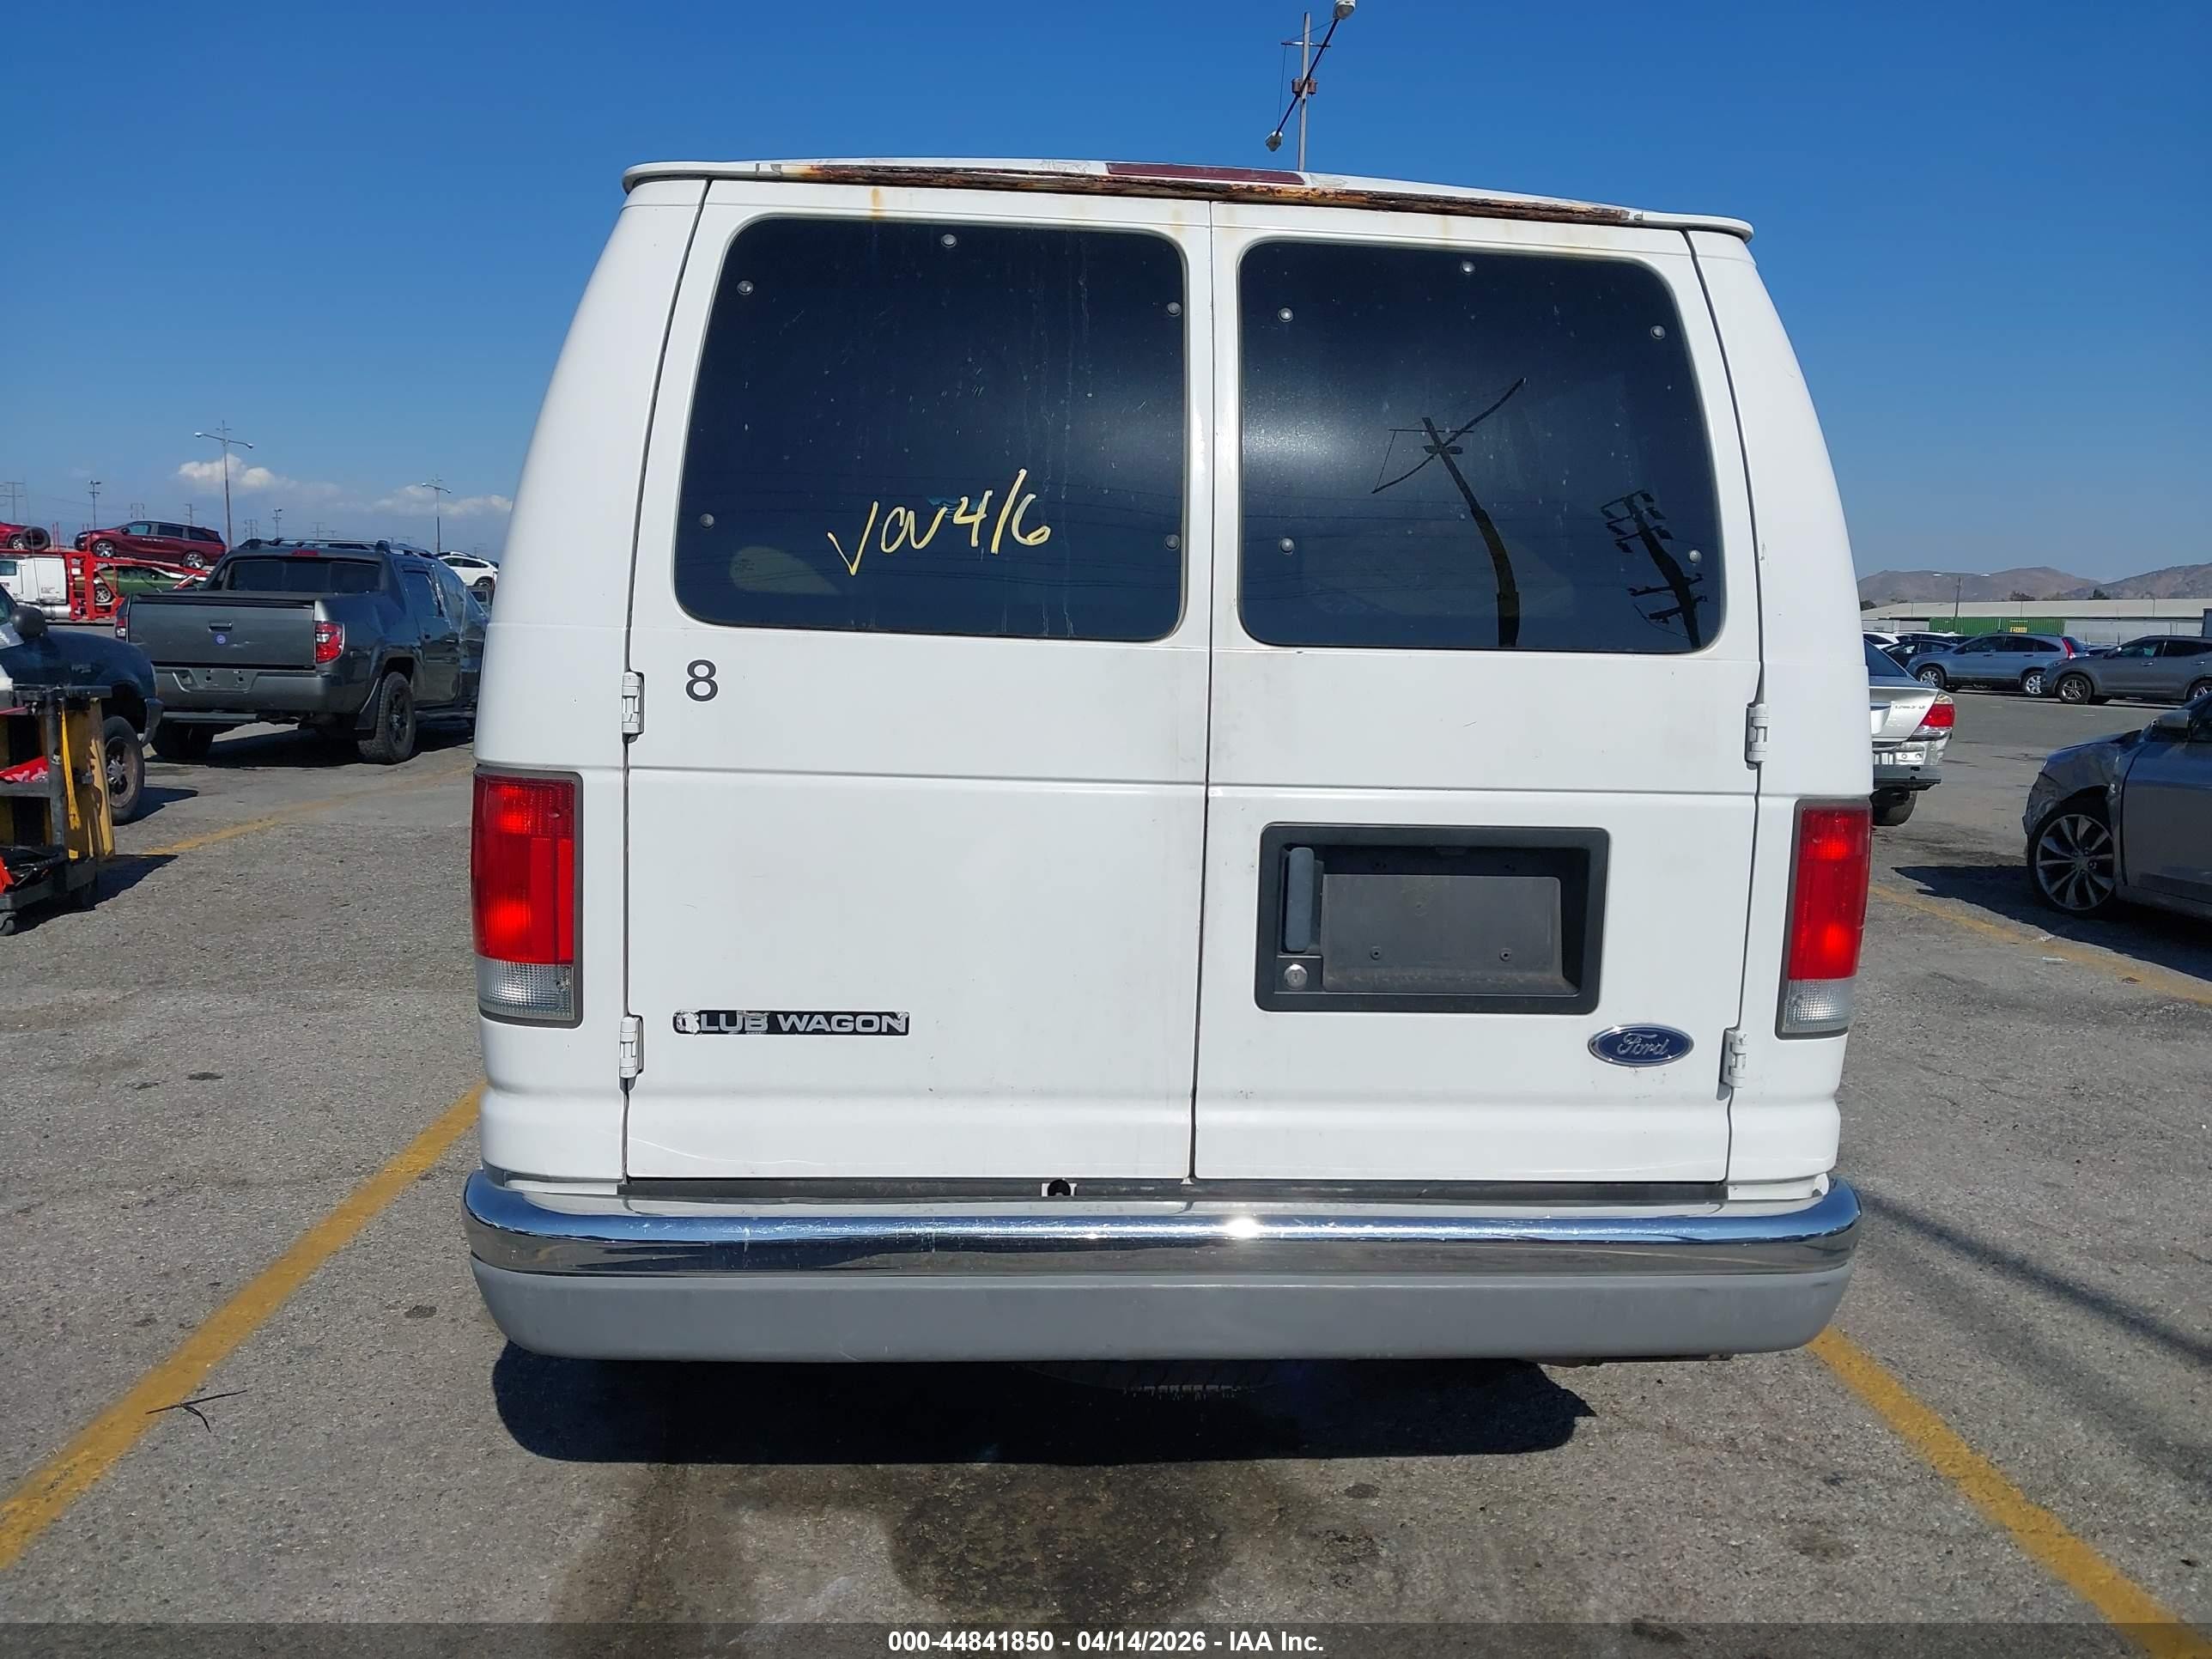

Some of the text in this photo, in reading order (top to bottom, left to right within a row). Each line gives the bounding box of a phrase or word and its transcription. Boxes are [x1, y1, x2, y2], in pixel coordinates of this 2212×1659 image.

[685, 659, 719, 702] 8
[776, 1013, 907, 1033] WAGON
[1615, 1032, 1670, 1055] Ford
